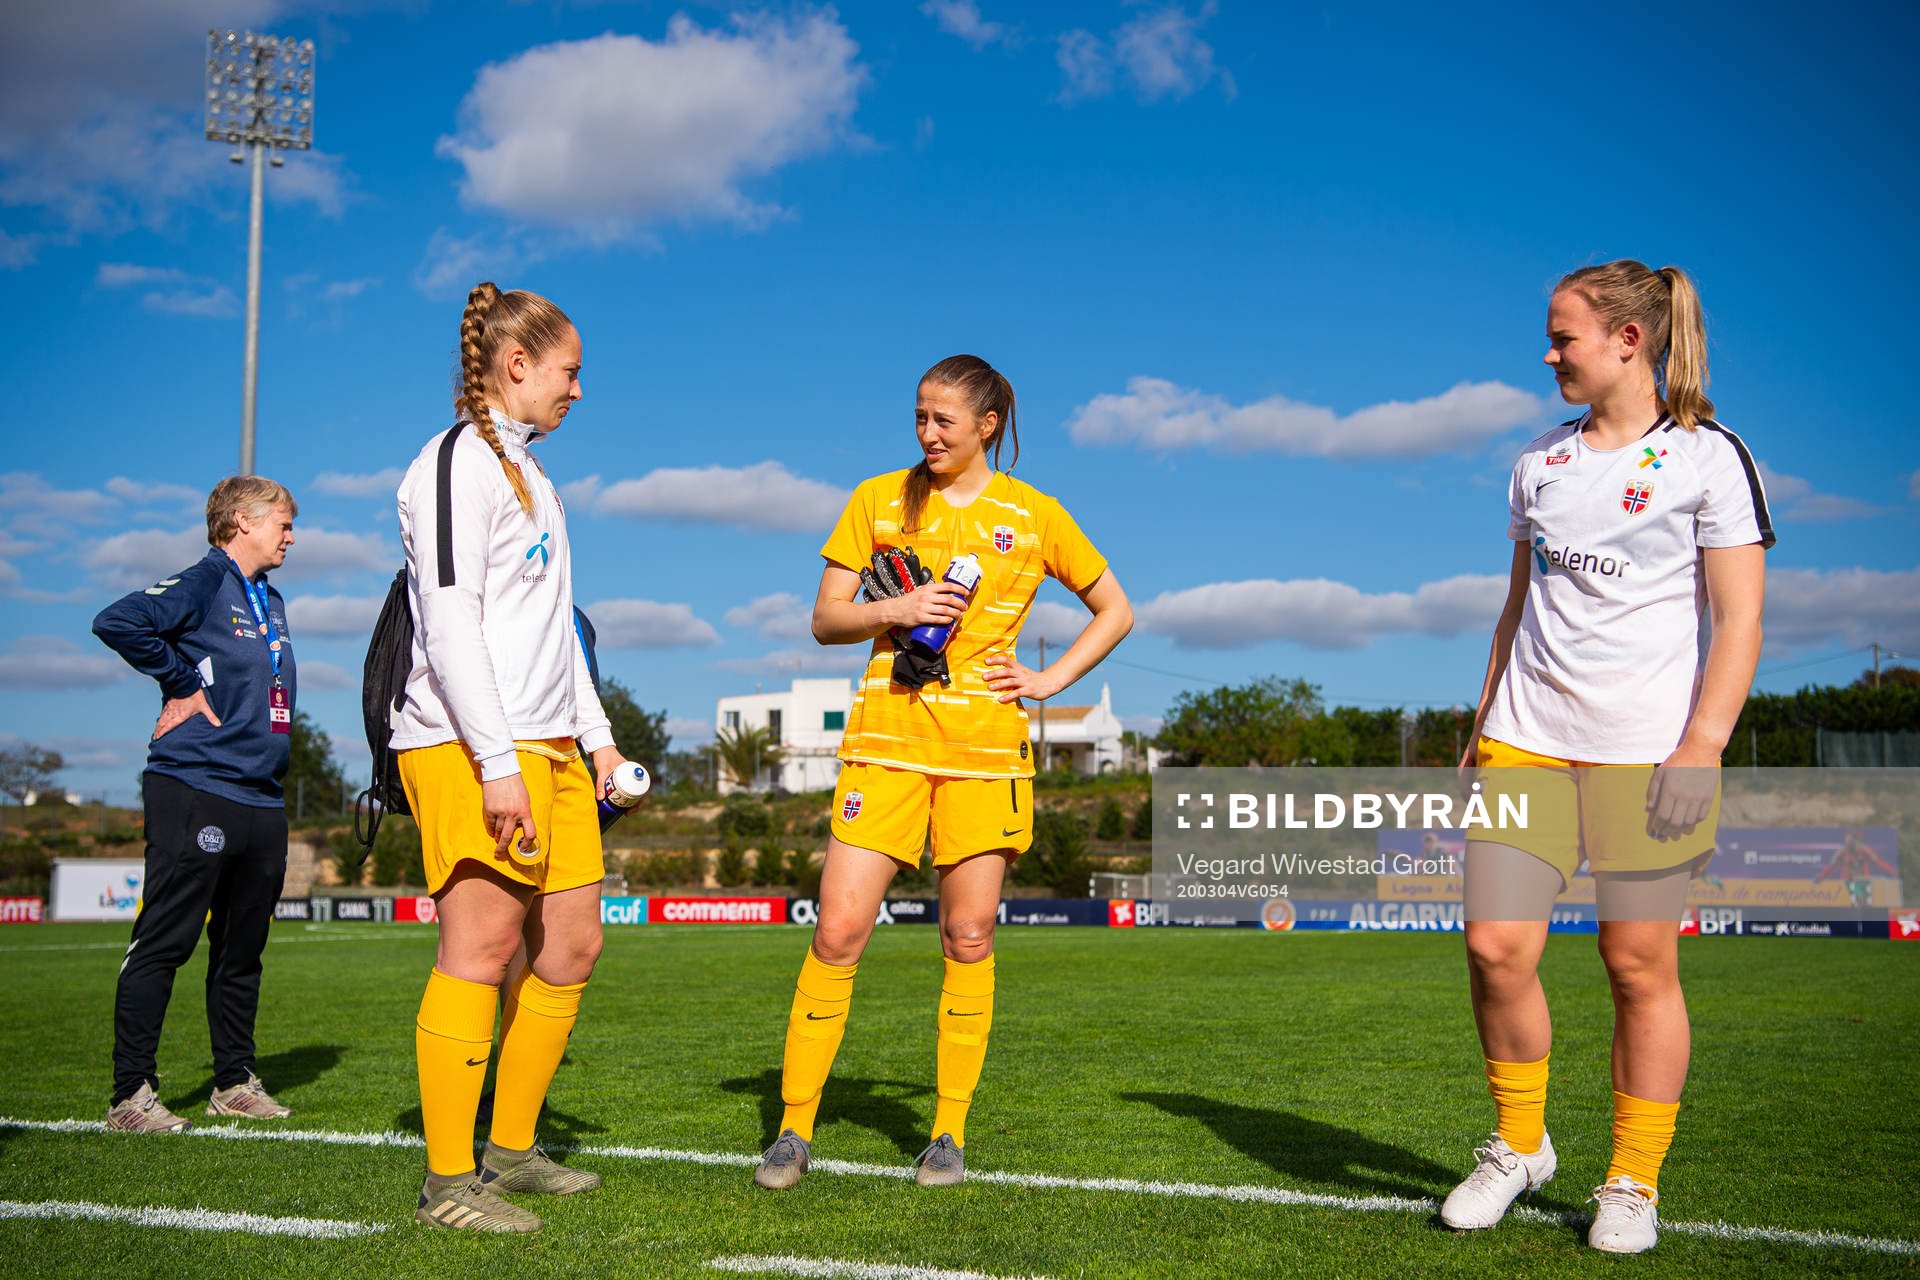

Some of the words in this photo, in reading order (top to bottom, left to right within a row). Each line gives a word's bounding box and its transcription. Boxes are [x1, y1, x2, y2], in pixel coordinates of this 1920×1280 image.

[1548, 456, 1567, 465] TINE
[1544, 545, 1630, 578] telenor
[0, 900, 40, 921] NTE
[663, 902, 771, 921] CONTINENTE
[890, 901, 925, 915] altice
[1135, 903, 1169, 926] BPI
[1700, 908, 1742, 935] BPI
